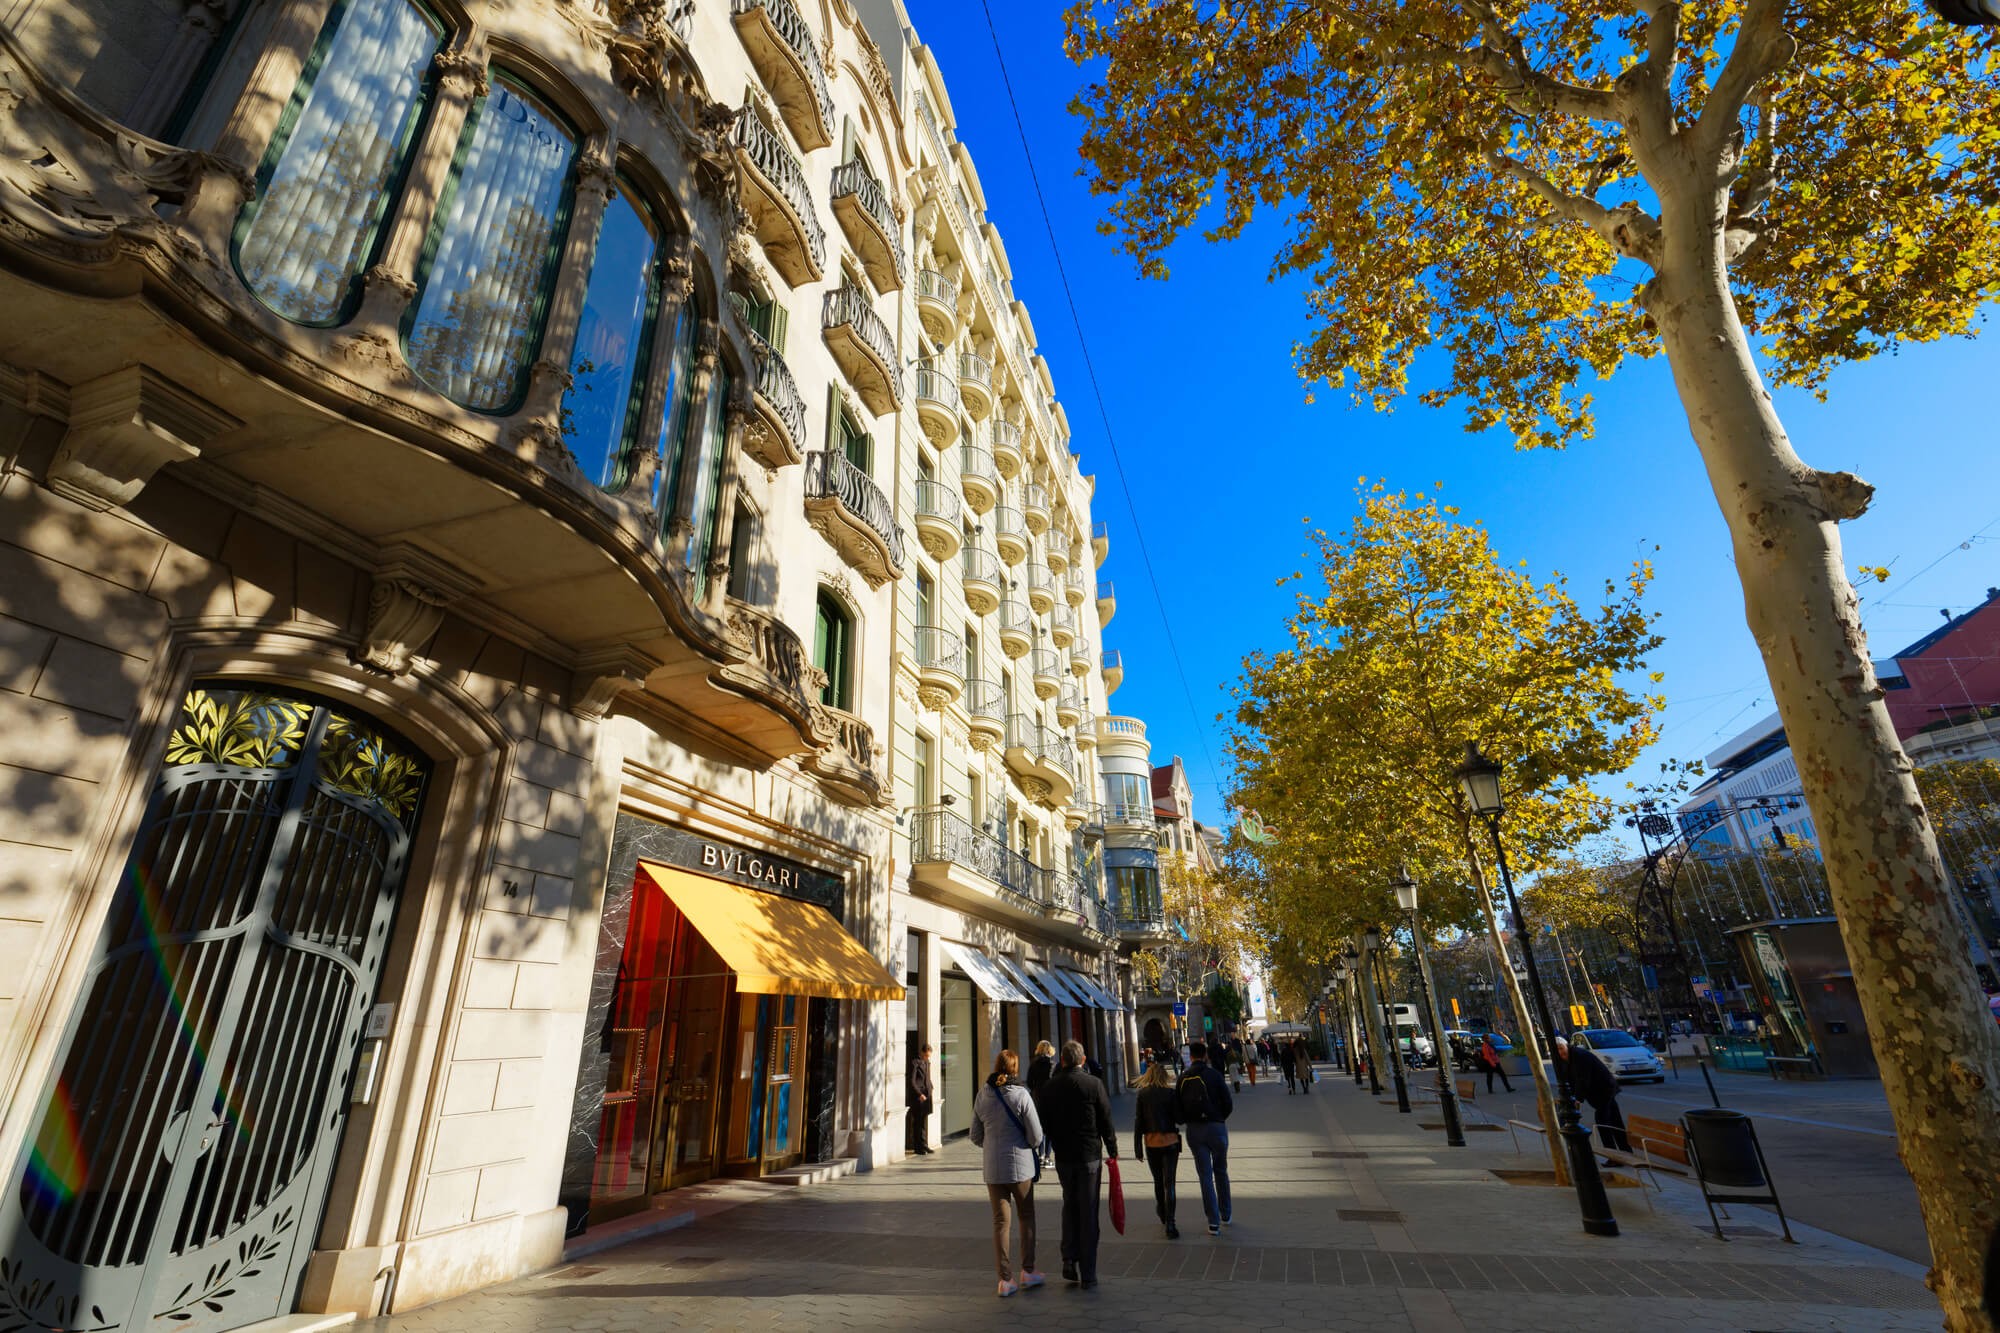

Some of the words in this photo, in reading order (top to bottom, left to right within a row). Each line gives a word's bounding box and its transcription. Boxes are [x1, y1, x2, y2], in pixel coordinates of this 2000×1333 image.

[498, 88, 565, 153] Dior
[503, 880, 519, 898] 74
[702, 844, 799, 889] BVLGARI
